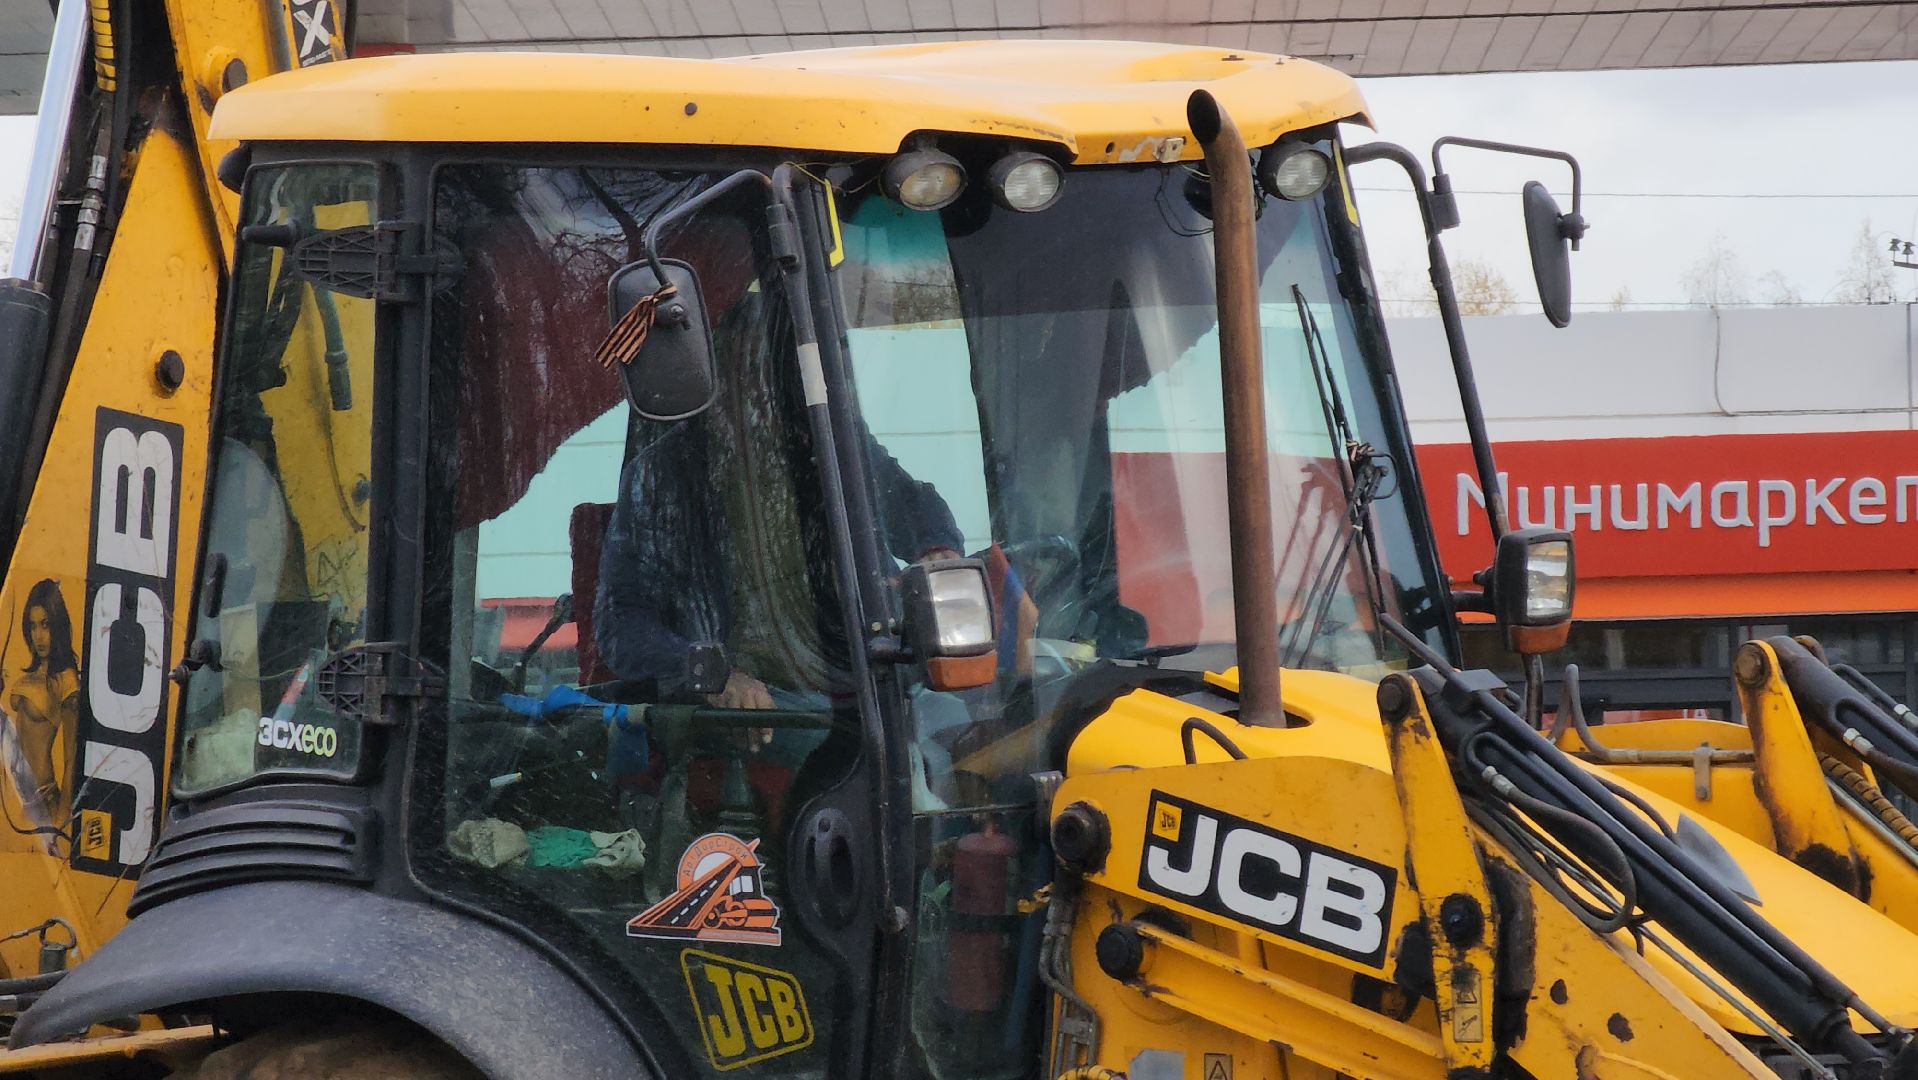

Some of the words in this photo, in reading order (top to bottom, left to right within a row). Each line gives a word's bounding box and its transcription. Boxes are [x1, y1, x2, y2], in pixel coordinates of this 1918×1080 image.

[292, 0, 330, 58] X
[84, 427, 173, 866] JCB
[88, 816, 103, 846] JCB
[1161, 810, 1176, 829] JCB
[1147, 814, 1386, 954] JCB
[703, 963, 805, 1057] JCB
